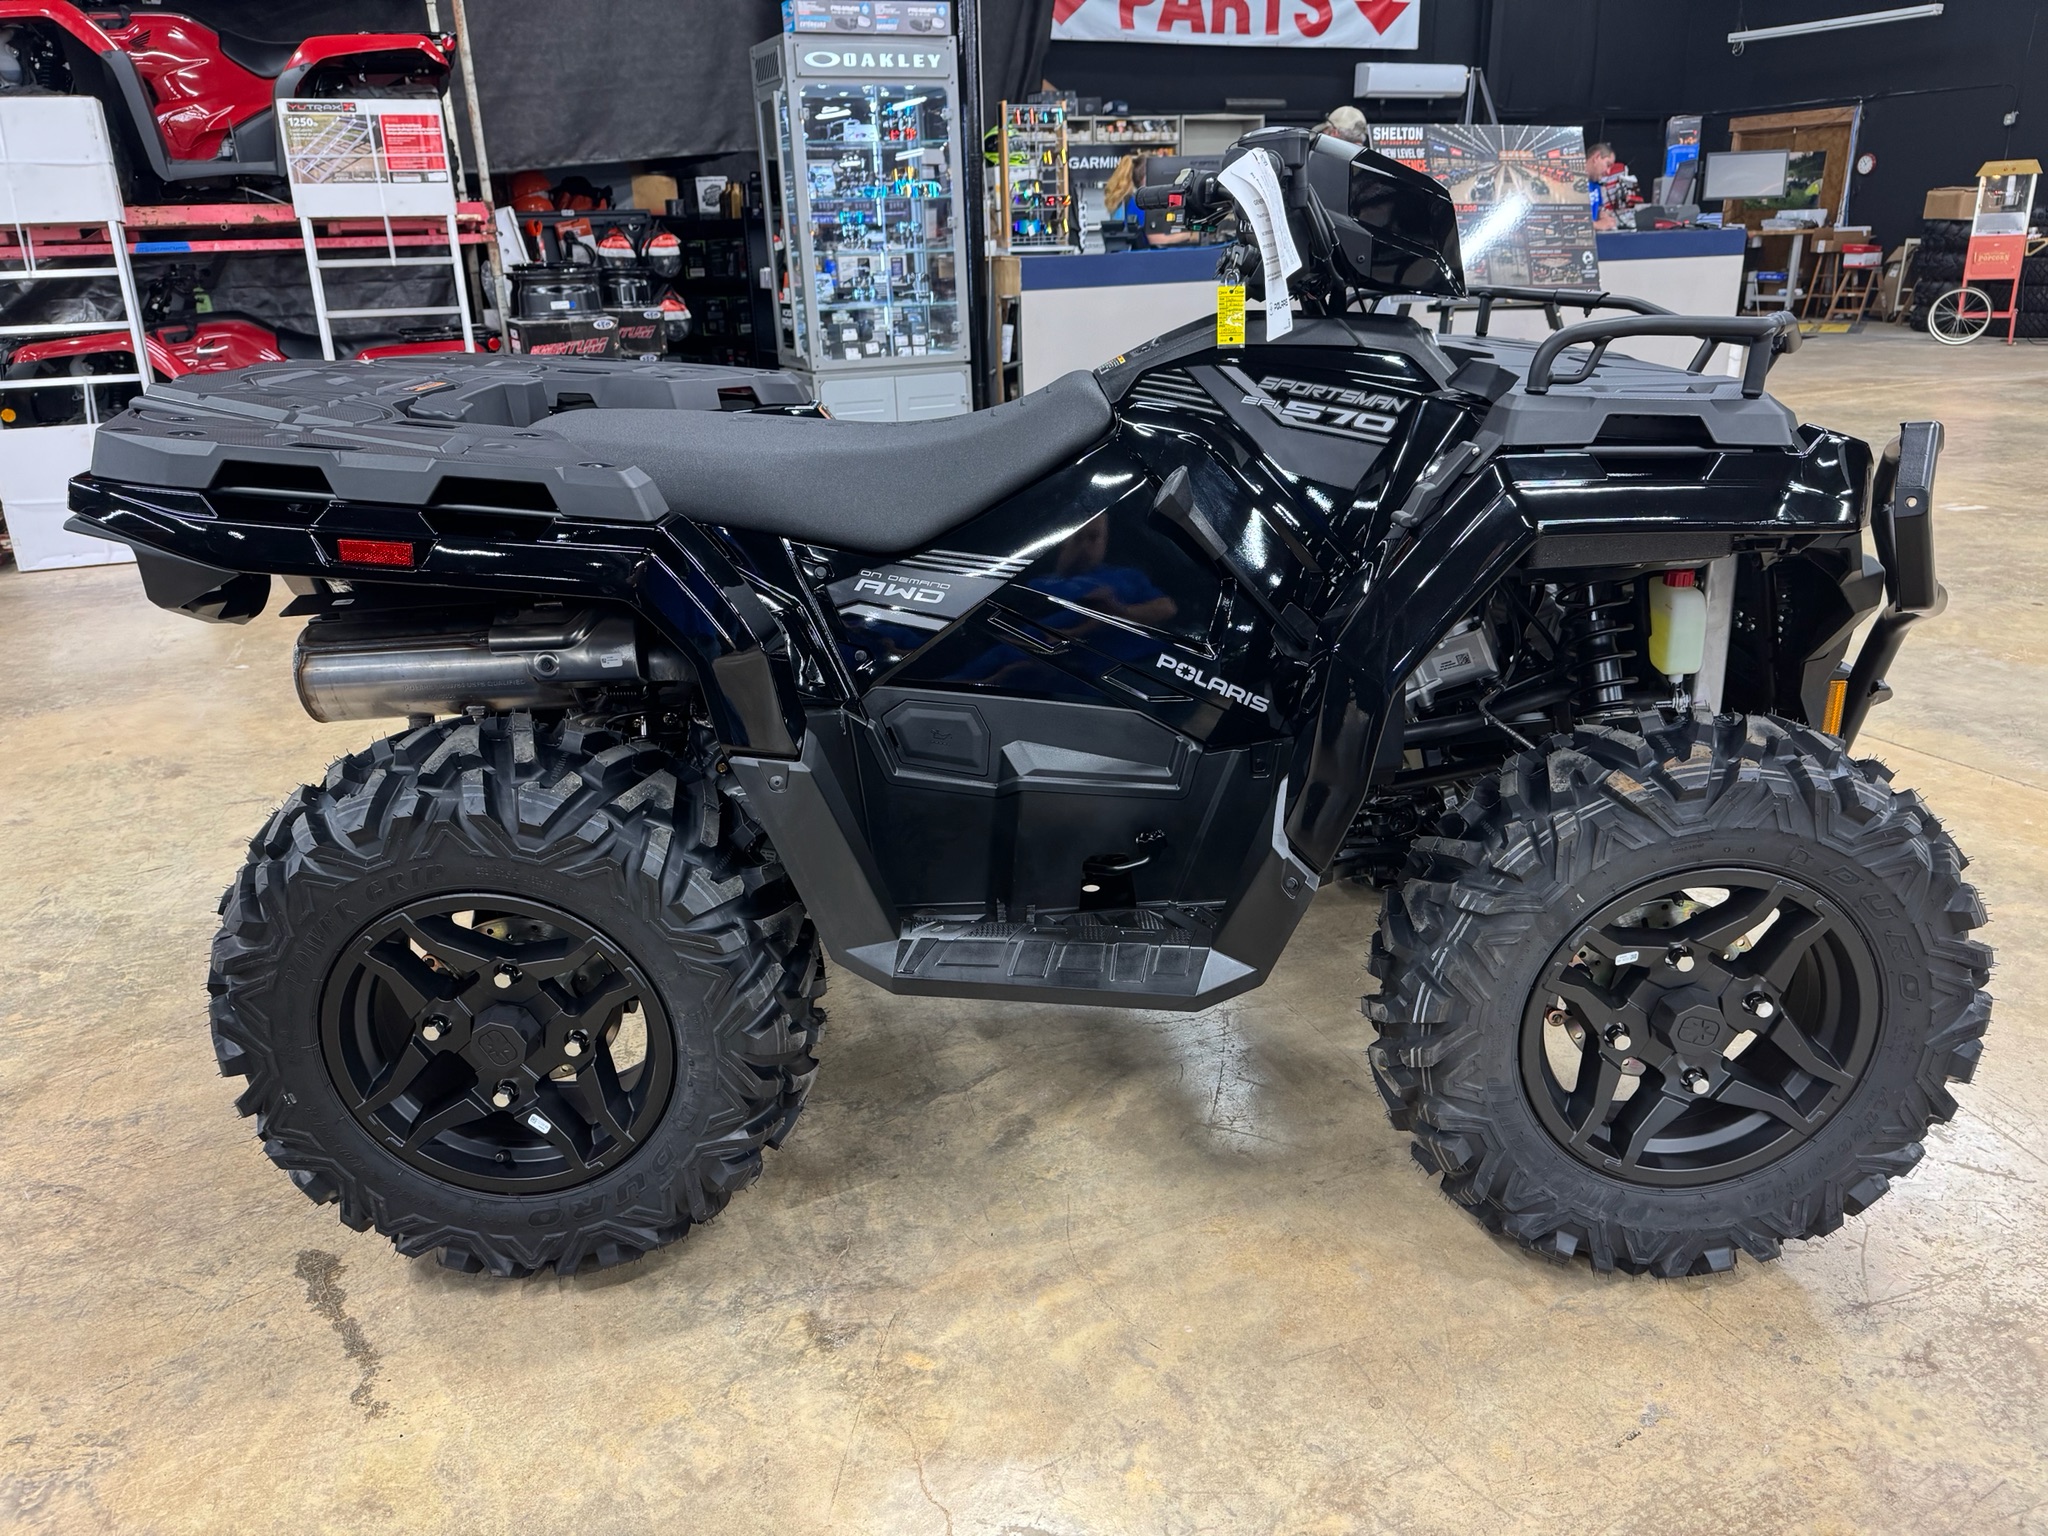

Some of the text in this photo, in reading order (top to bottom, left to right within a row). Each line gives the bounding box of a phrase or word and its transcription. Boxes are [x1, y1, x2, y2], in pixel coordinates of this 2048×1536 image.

[842, 52, 941, 68] OAKLEY
[1373, 126, 1424, 141] SHELTON
[1068, 155, 1122, 170] GARMIN
[1397, 148, 1416, 159] LEVEL
[1416, 148, 1426, 159] OF
[1257, 375, 1411, 413] SPORTSMAN
[1241, 395, 1399, 434] EFI 570
[853, 578, 946, 604] AWD
[860, 569, 951, 590] ON DEMAND
[1156, 653, 1271, 713] POLARIS
[365, 863, 444, 903] GRIP
[1827, 865, 1921, 1002] DURO
[527, 1140, 678, 1228] DURO
